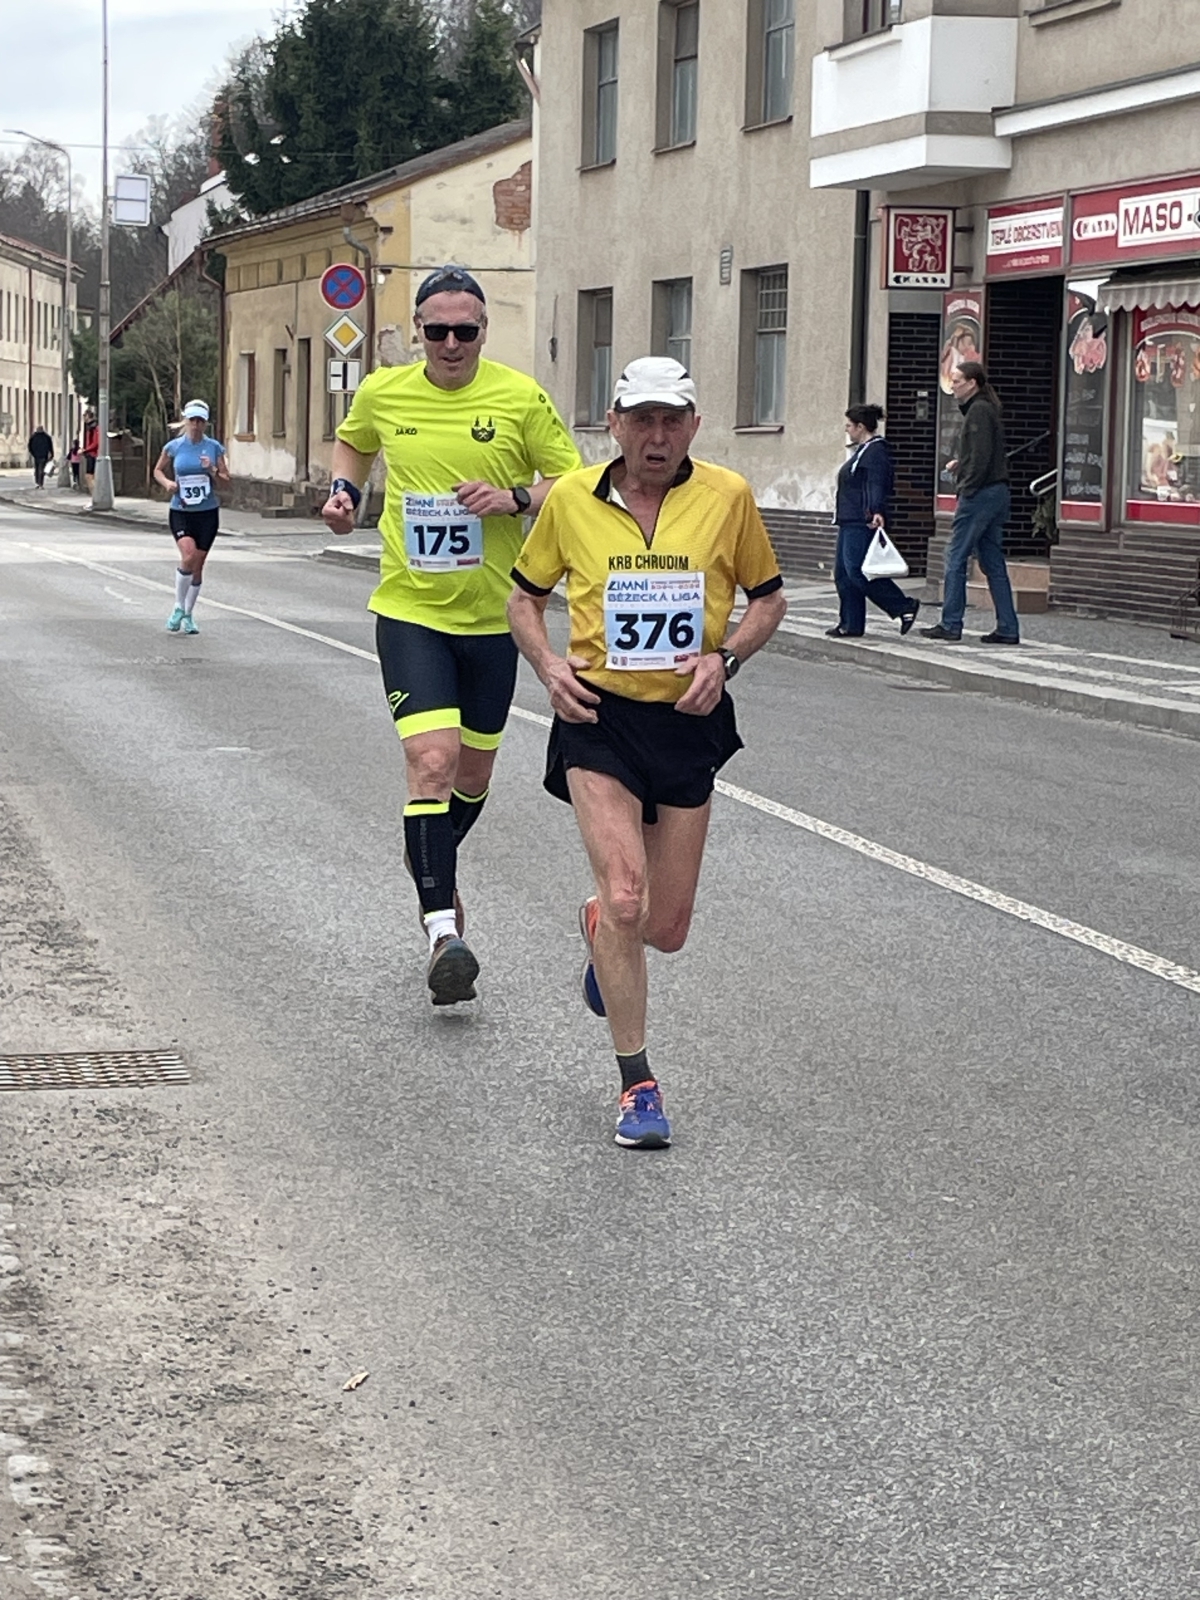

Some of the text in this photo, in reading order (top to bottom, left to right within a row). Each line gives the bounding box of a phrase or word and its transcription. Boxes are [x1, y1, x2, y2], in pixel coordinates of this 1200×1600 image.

[1123, 201, 1183, 236] MASO
[395, 426, 418, 437] JAKO
[184, 485, 206, 498] 391
[413, 525, 470, 556] 175
[608, 554, 689, 570] KRB CHRUDIM
[607, 579, 649, 591] ZIMNÍ
[671, 592, 701, 602] LIGA
[615, 612, 694, 651] 376
